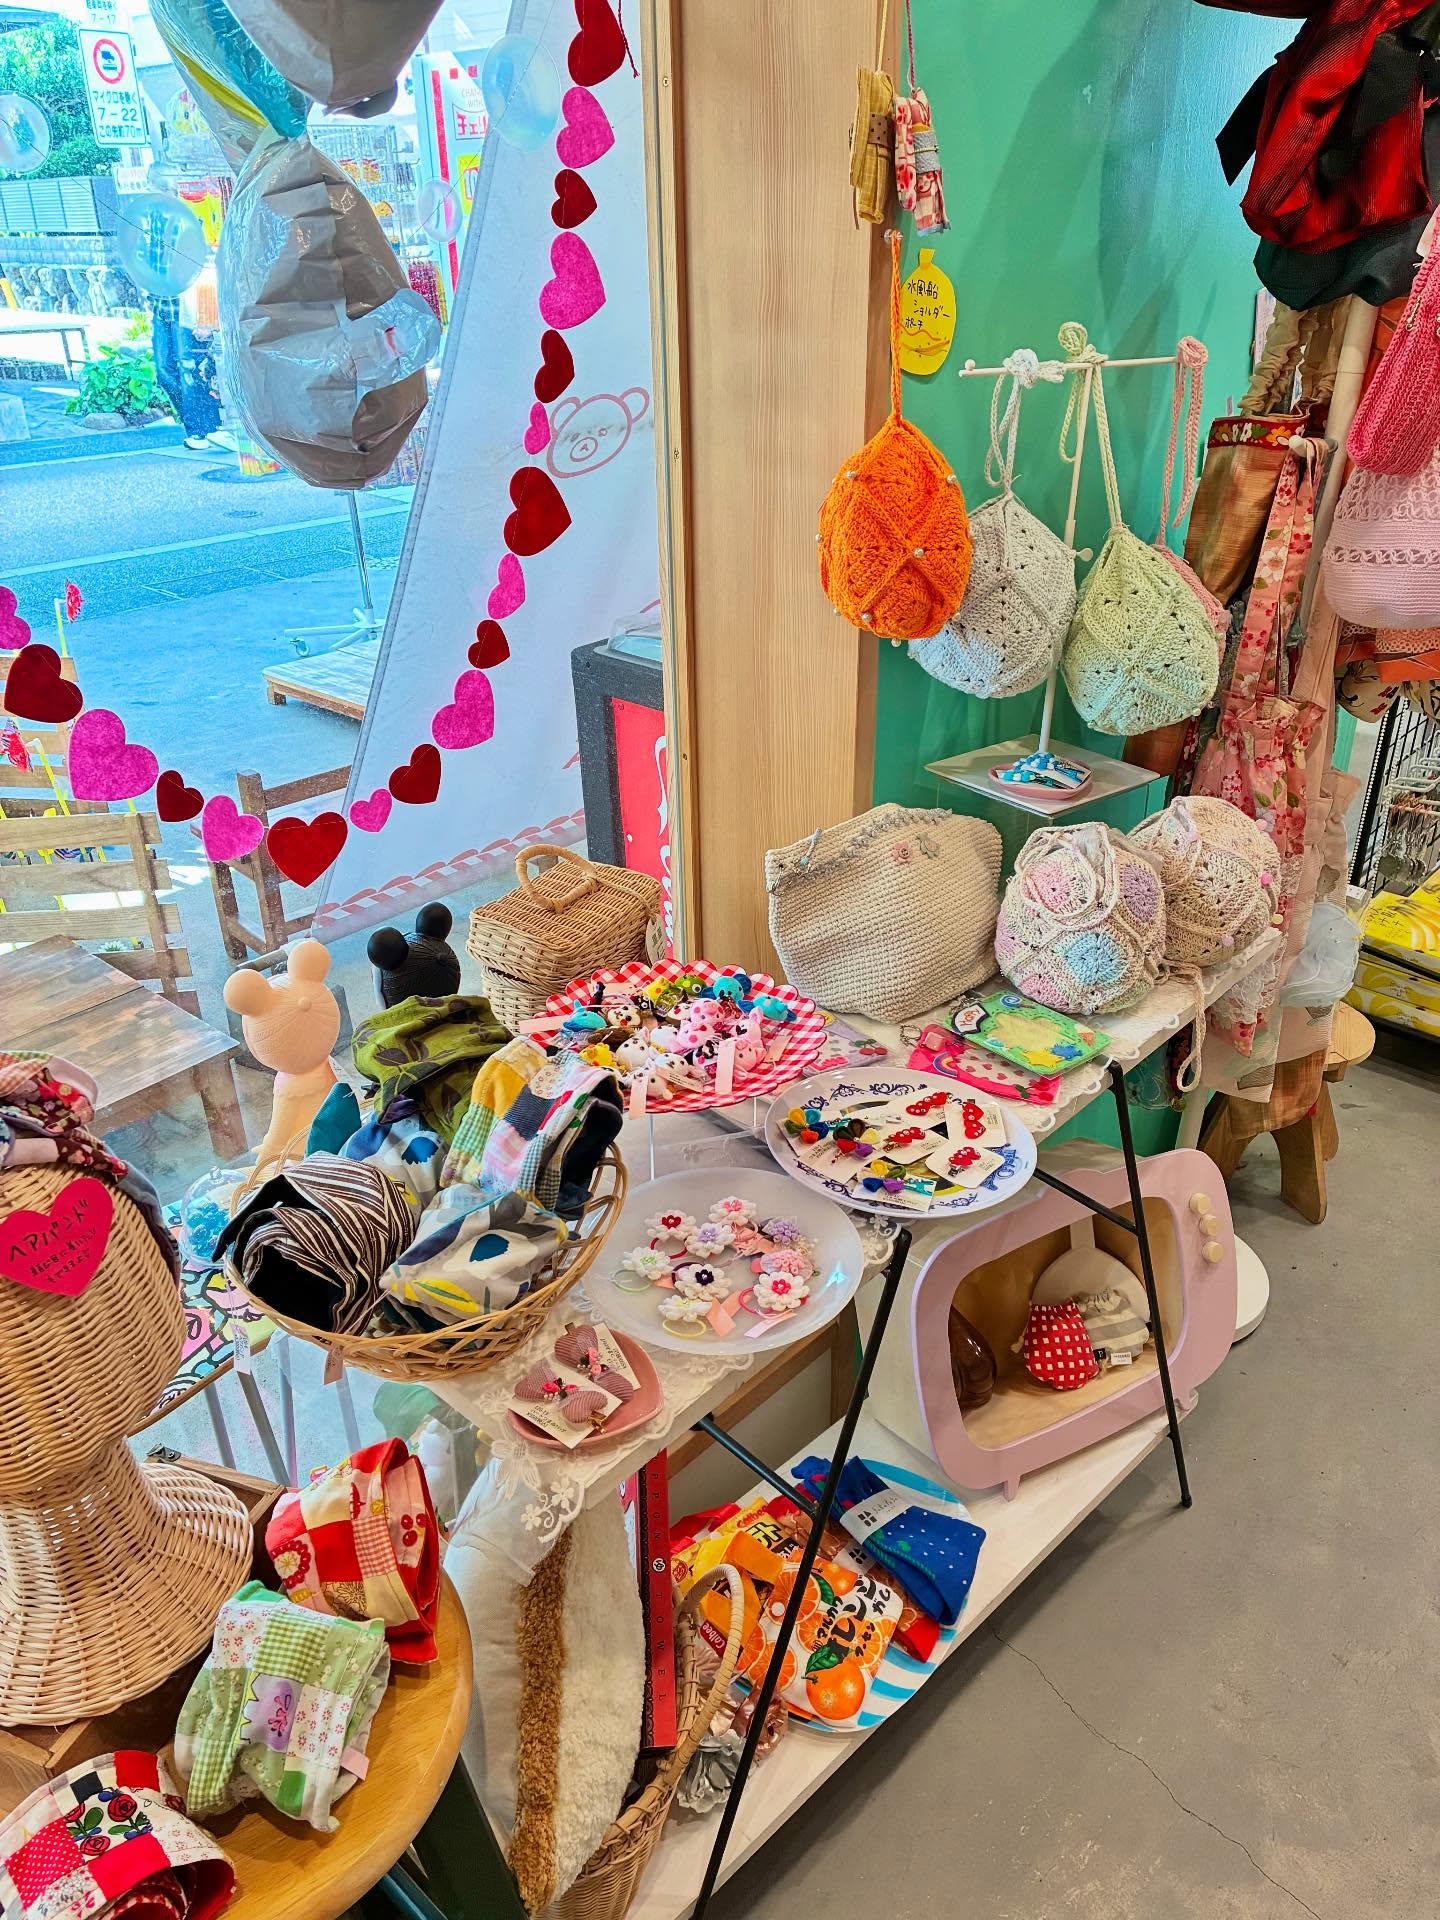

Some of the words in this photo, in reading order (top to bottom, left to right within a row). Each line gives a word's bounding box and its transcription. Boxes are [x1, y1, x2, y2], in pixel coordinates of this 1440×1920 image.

[907, 279, 939, 300] 水風船
[872, 1587, 892, 1616] ガム
[816, 1595, 844, 1639] マルカワ
[702, 1622, 726, 1649] Calbee
